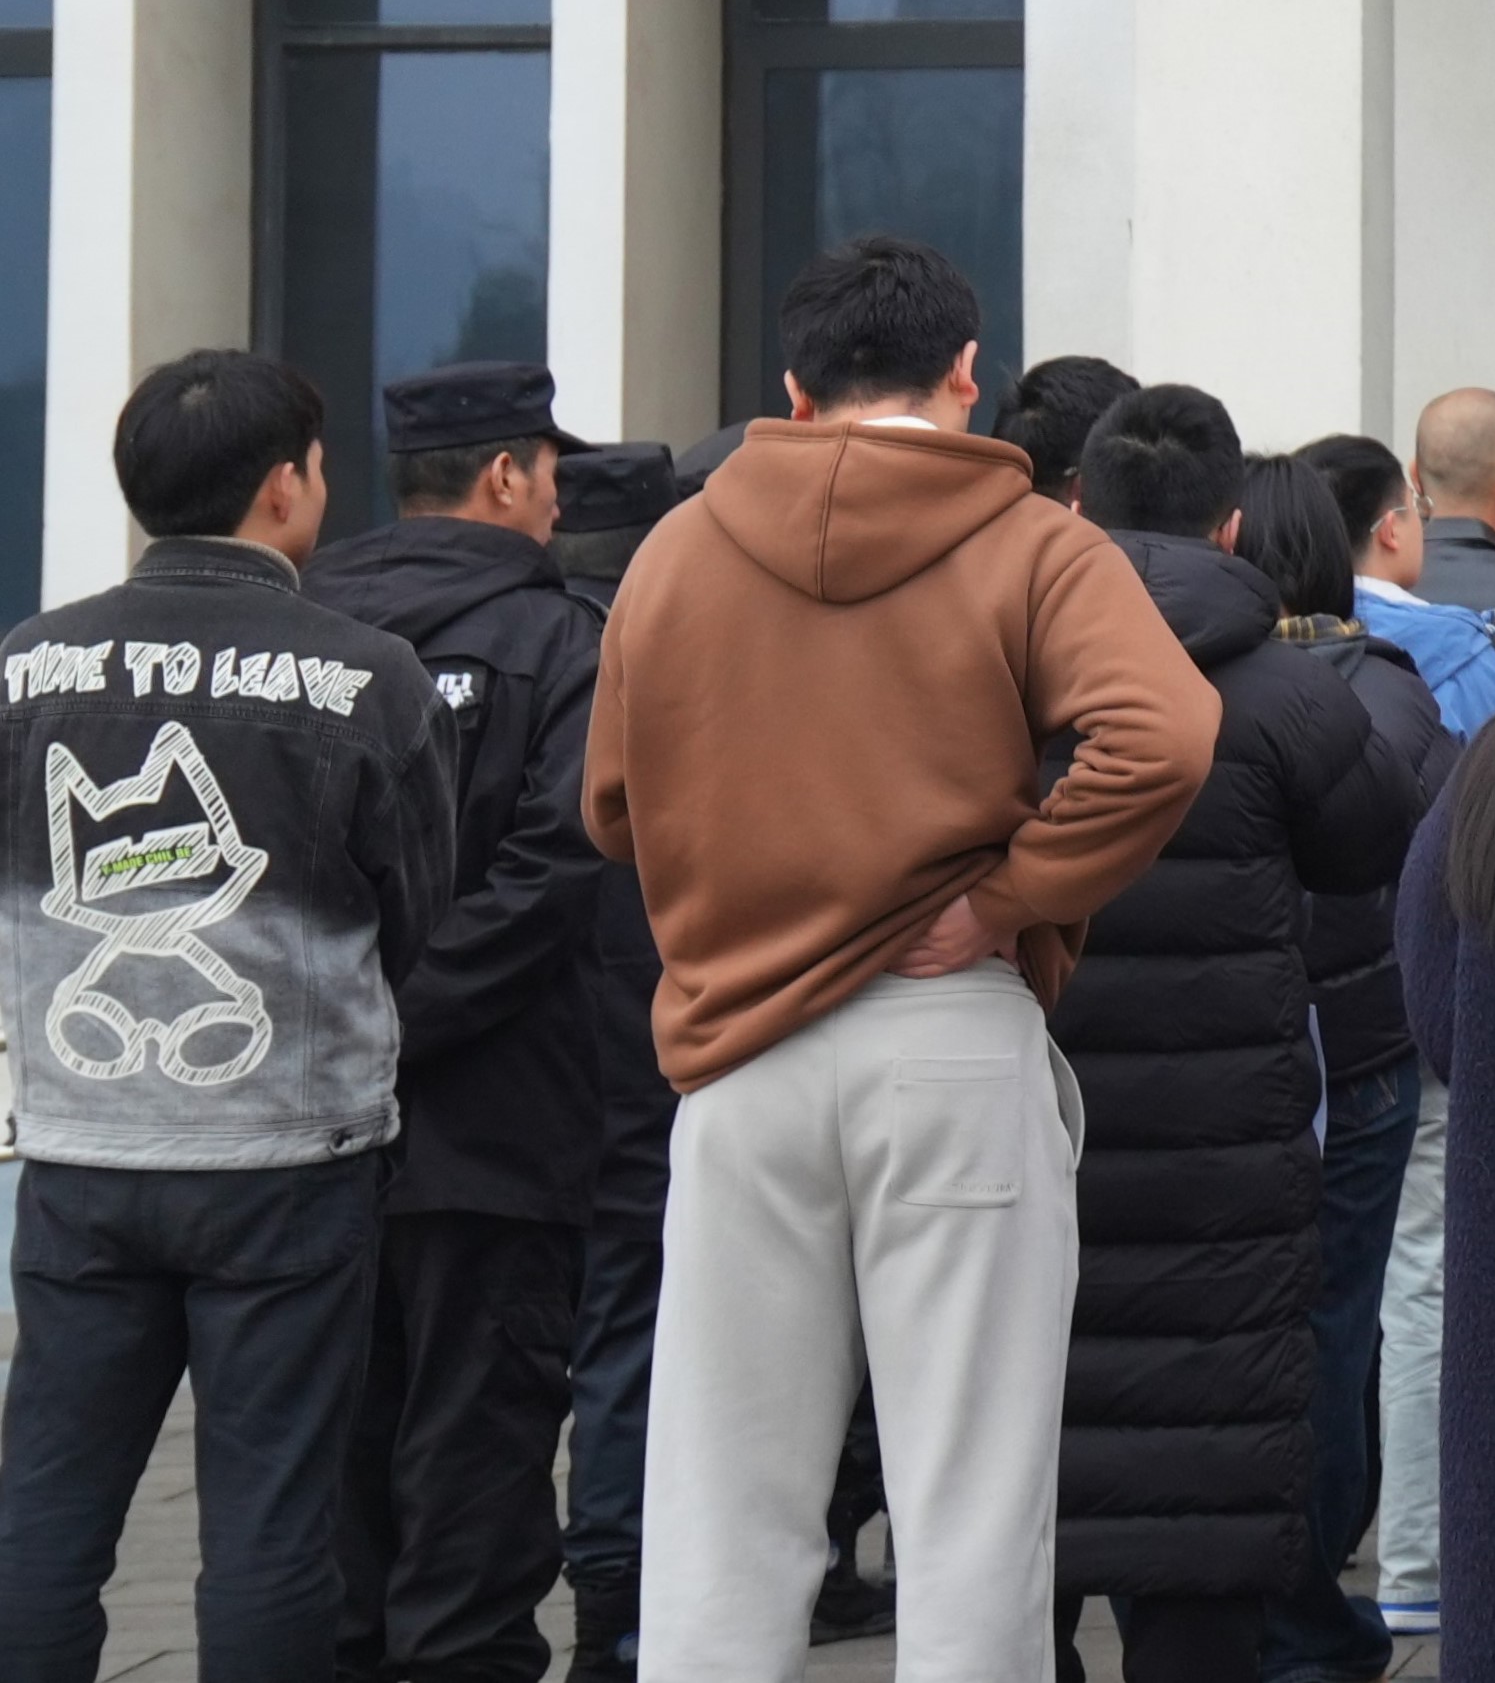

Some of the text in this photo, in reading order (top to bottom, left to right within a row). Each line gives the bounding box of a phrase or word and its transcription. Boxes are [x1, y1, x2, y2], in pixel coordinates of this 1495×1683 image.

[5, 640, 114, 704] TIME
[124, 641, 201, 698] TO
[211, 646, 373, 717] LEAVE
